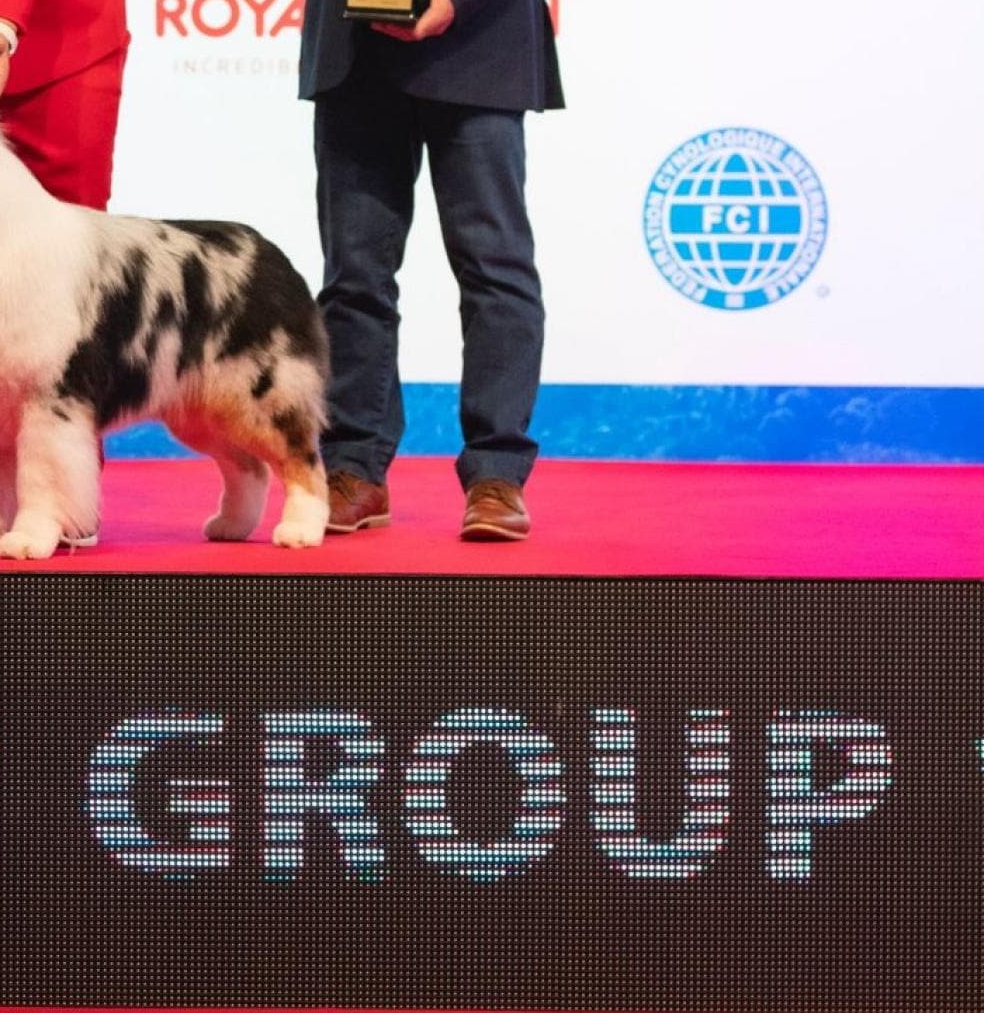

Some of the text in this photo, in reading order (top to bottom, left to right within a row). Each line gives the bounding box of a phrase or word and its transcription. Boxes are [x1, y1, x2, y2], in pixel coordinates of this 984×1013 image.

[173, 58, 297, 76] INCREDIB
[702, 205, 770, 234] FCI
[85, 705, 893, 883] GROUP
